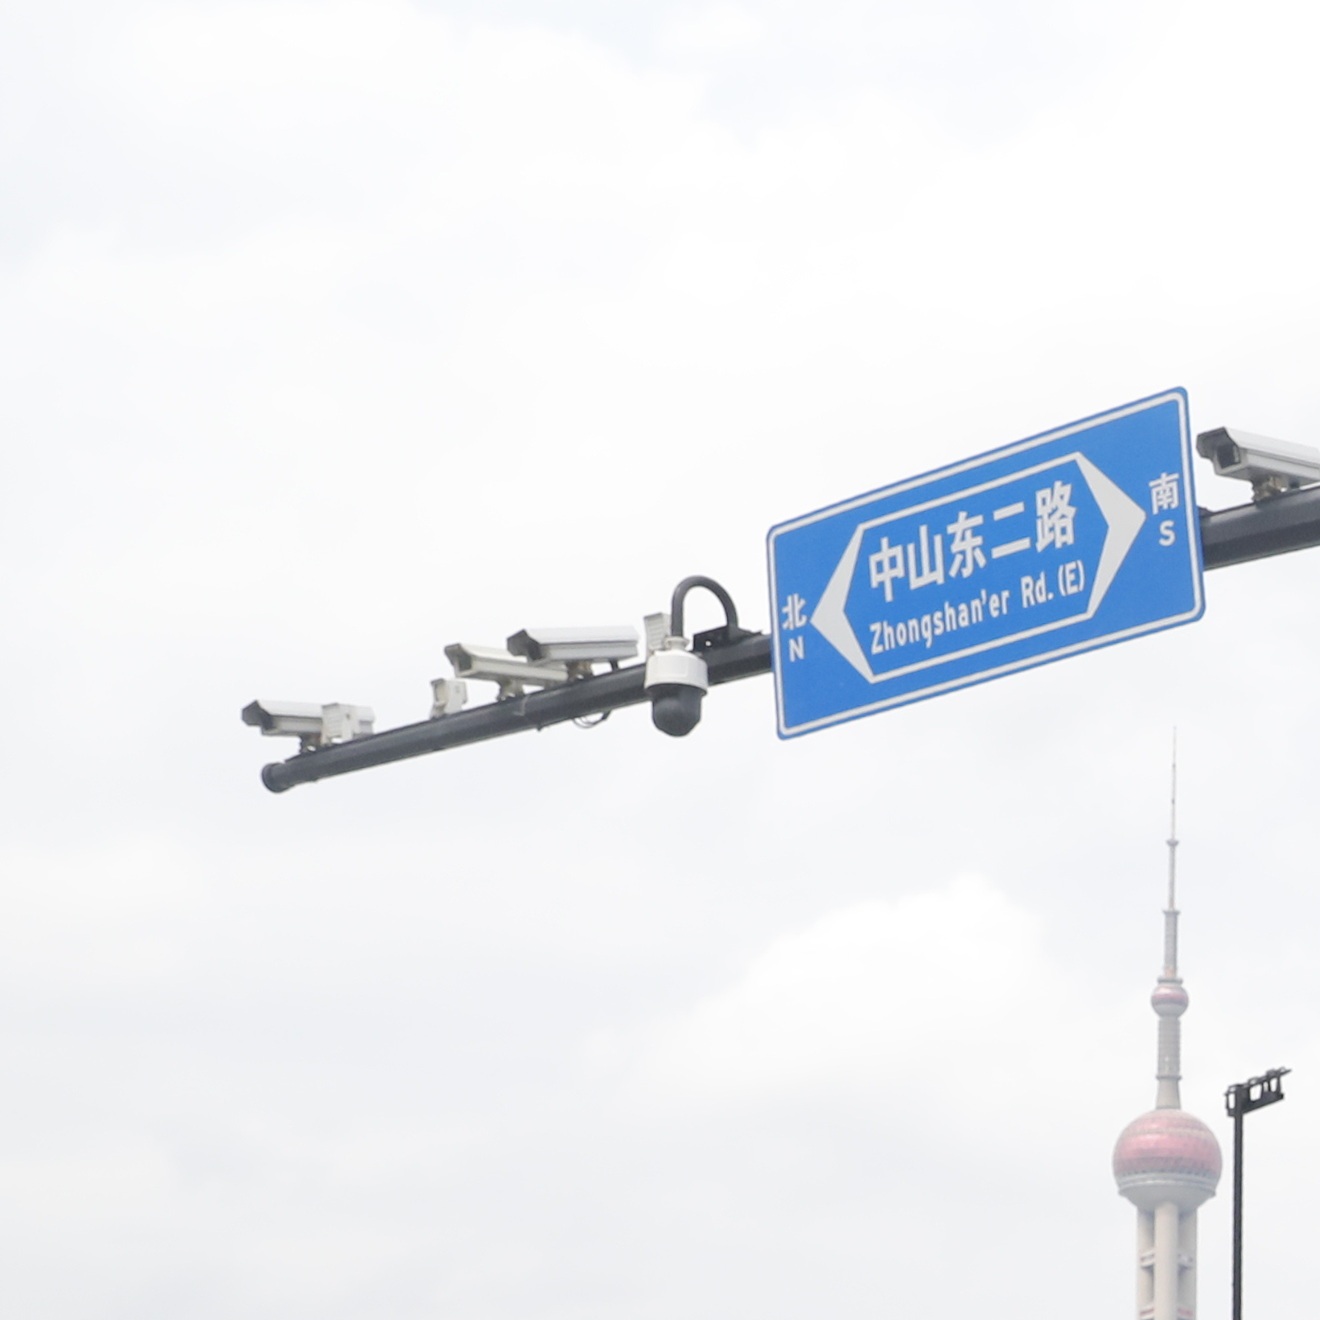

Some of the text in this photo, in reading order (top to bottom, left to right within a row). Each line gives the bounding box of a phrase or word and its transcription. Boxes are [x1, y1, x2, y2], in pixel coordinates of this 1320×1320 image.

[1149, 473, 1179, 515] 南
[868, 481, 1076, 602] 中山东二路
[1158, 521, 1175, 546] S
[782, 594, 806, 630] 北
[869, 560, 1086, 655] Zhongshan'er Rd. (E)
[789, 635, 804, 662] N
